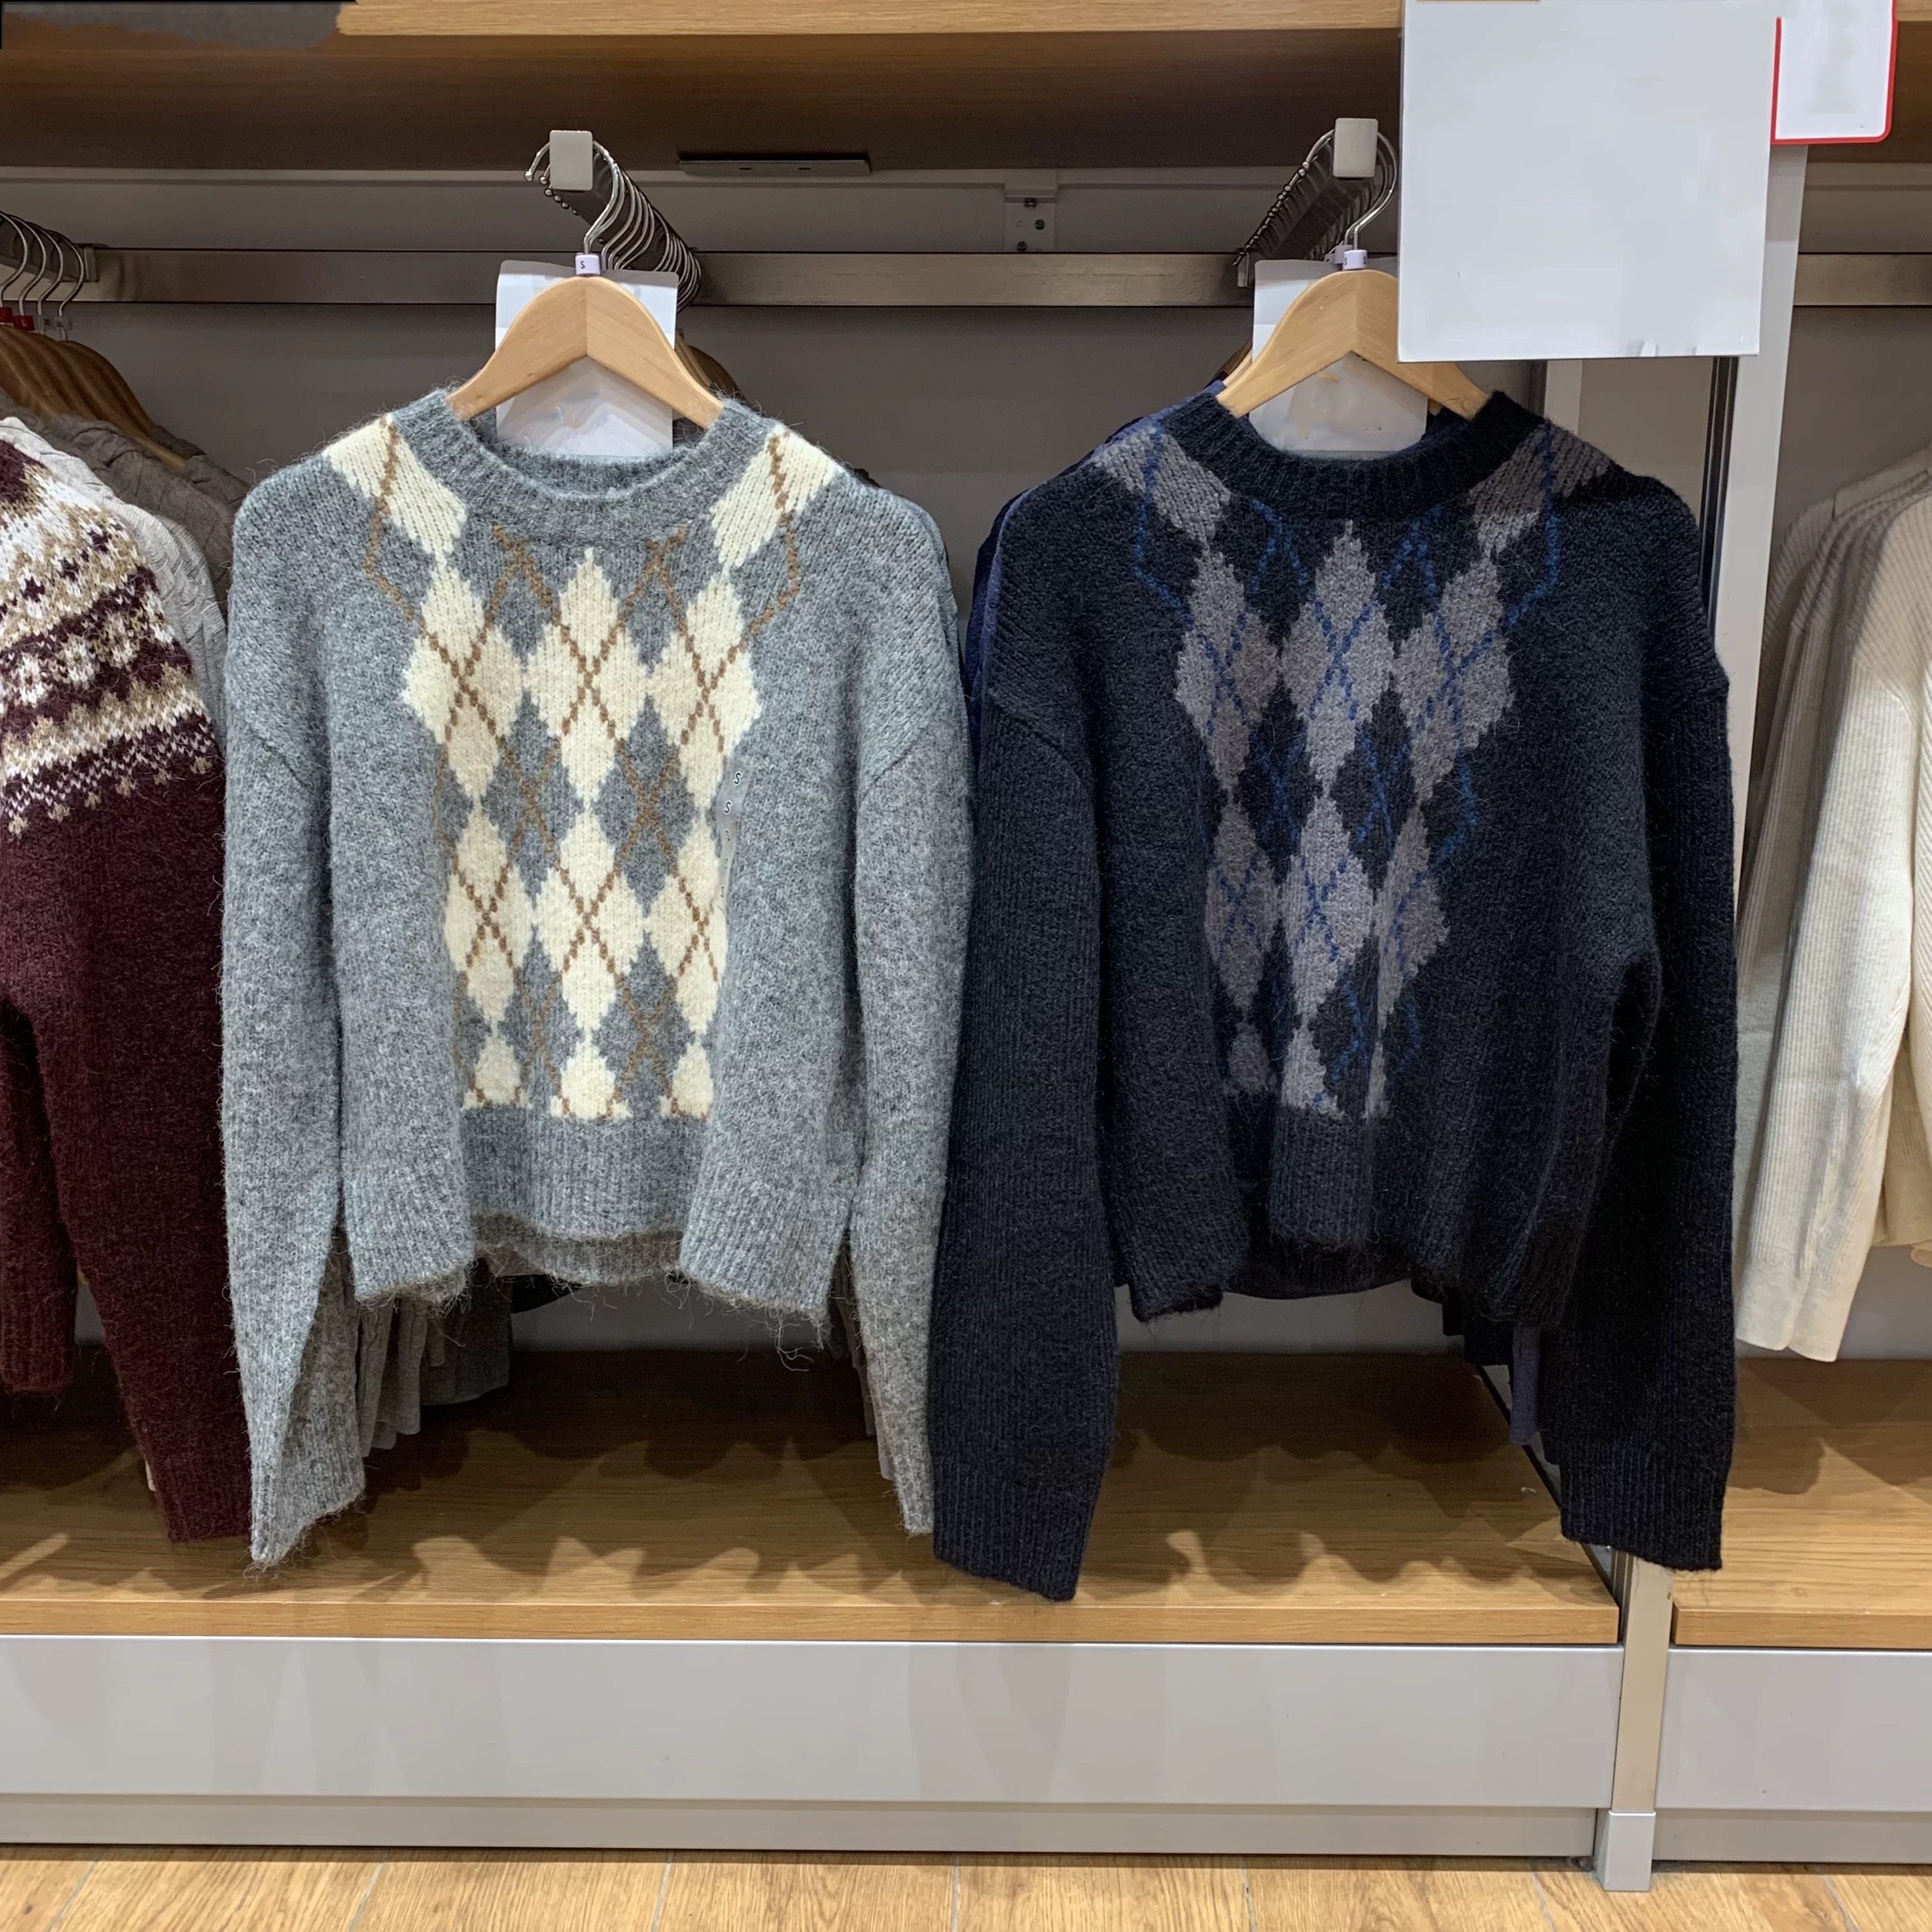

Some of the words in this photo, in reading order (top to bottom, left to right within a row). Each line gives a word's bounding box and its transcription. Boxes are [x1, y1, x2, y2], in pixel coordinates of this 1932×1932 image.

[580, 261, 586, 269] S
[734, 772, 742, 784] S
[724, 802, 731, 813] S
